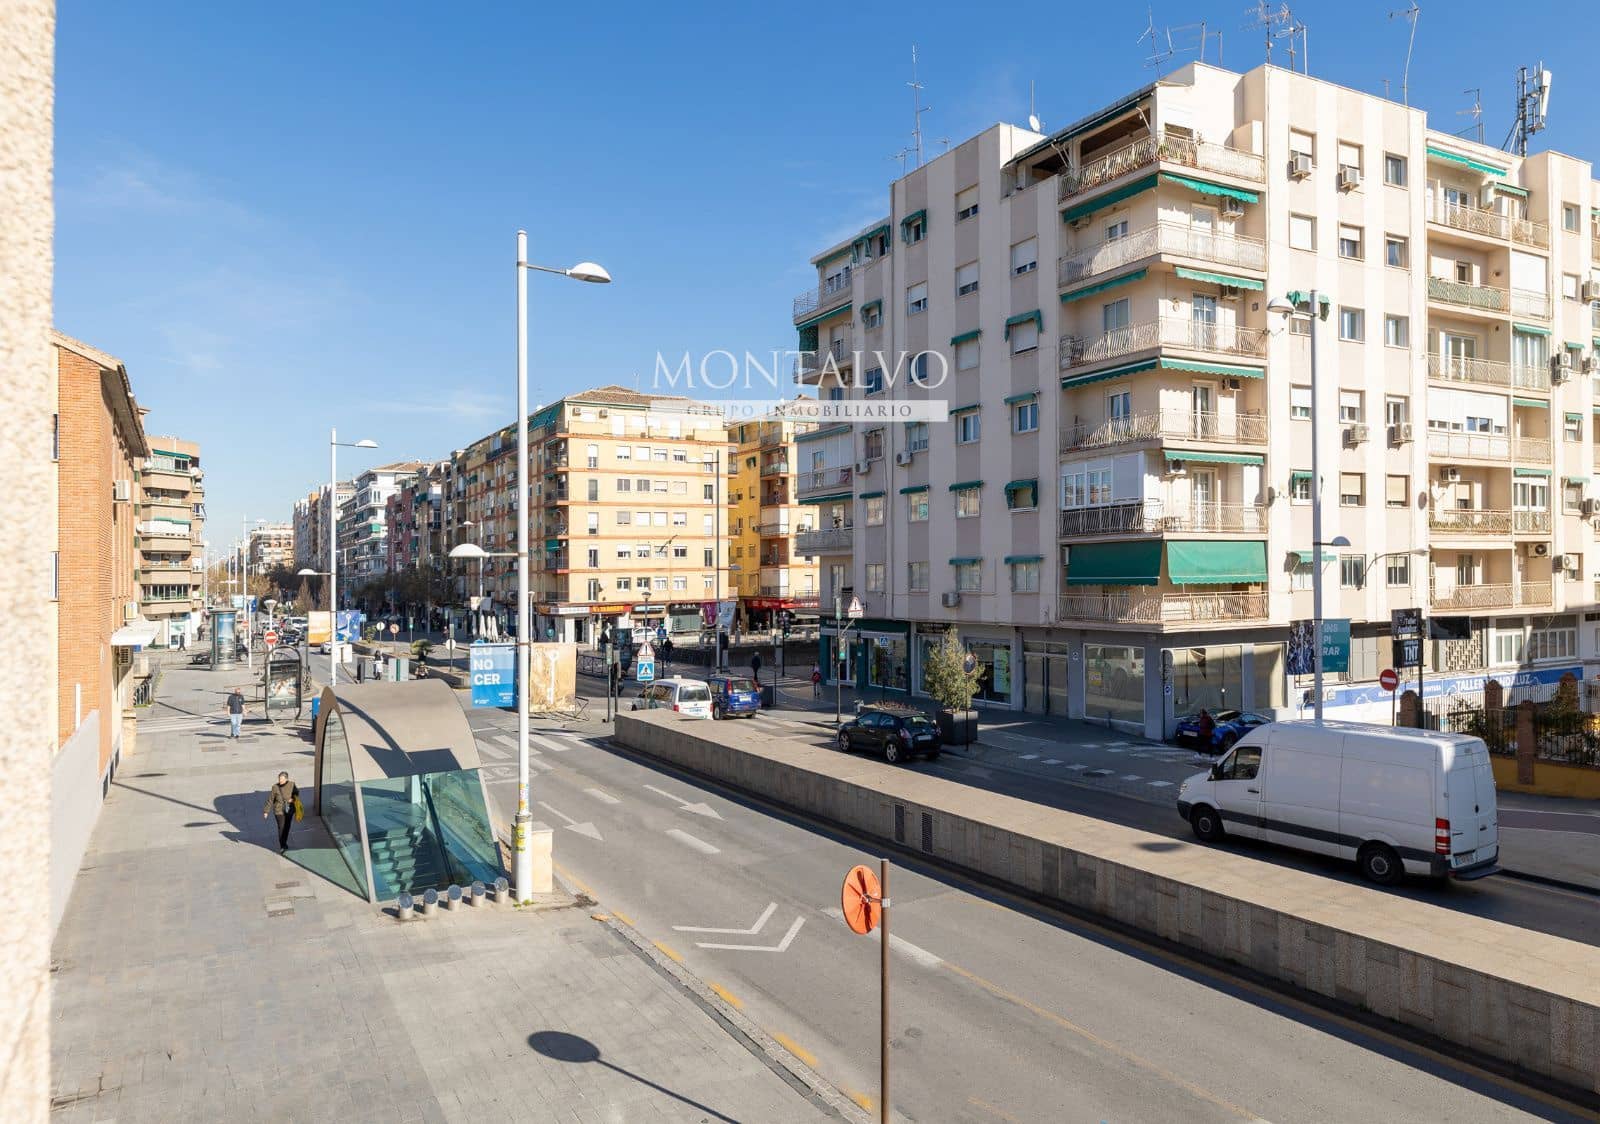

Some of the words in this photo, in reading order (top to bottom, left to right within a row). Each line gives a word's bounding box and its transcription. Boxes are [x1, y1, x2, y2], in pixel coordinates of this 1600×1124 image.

[1322, 646, 1340, 656] RAR
[1404, 646, 1419, 662] TNT
[473, 659, 494, 670] NO
[473, 673, 501, 685] CER
